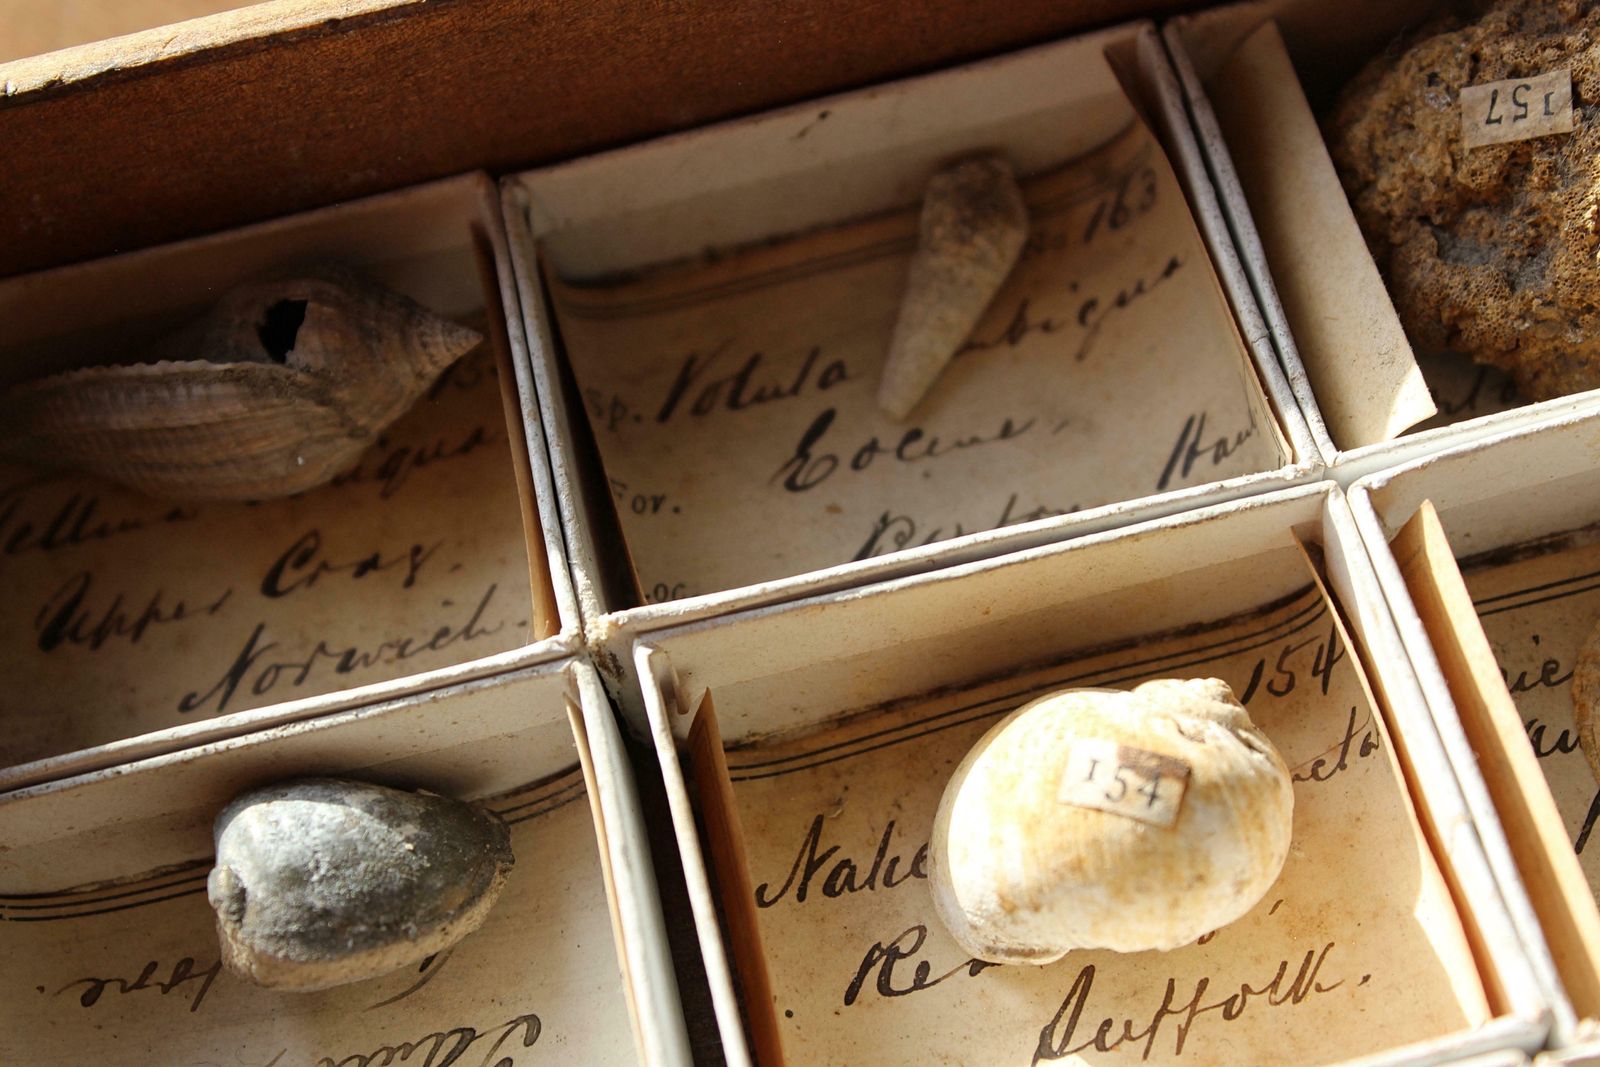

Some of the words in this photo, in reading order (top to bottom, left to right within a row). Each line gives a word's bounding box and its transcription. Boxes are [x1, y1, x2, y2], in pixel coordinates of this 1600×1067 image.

[1485, 83, 1556, 125] 157
[1242, 621, 1347, 706] 154
[1083, 757, 1164, 808] 154
